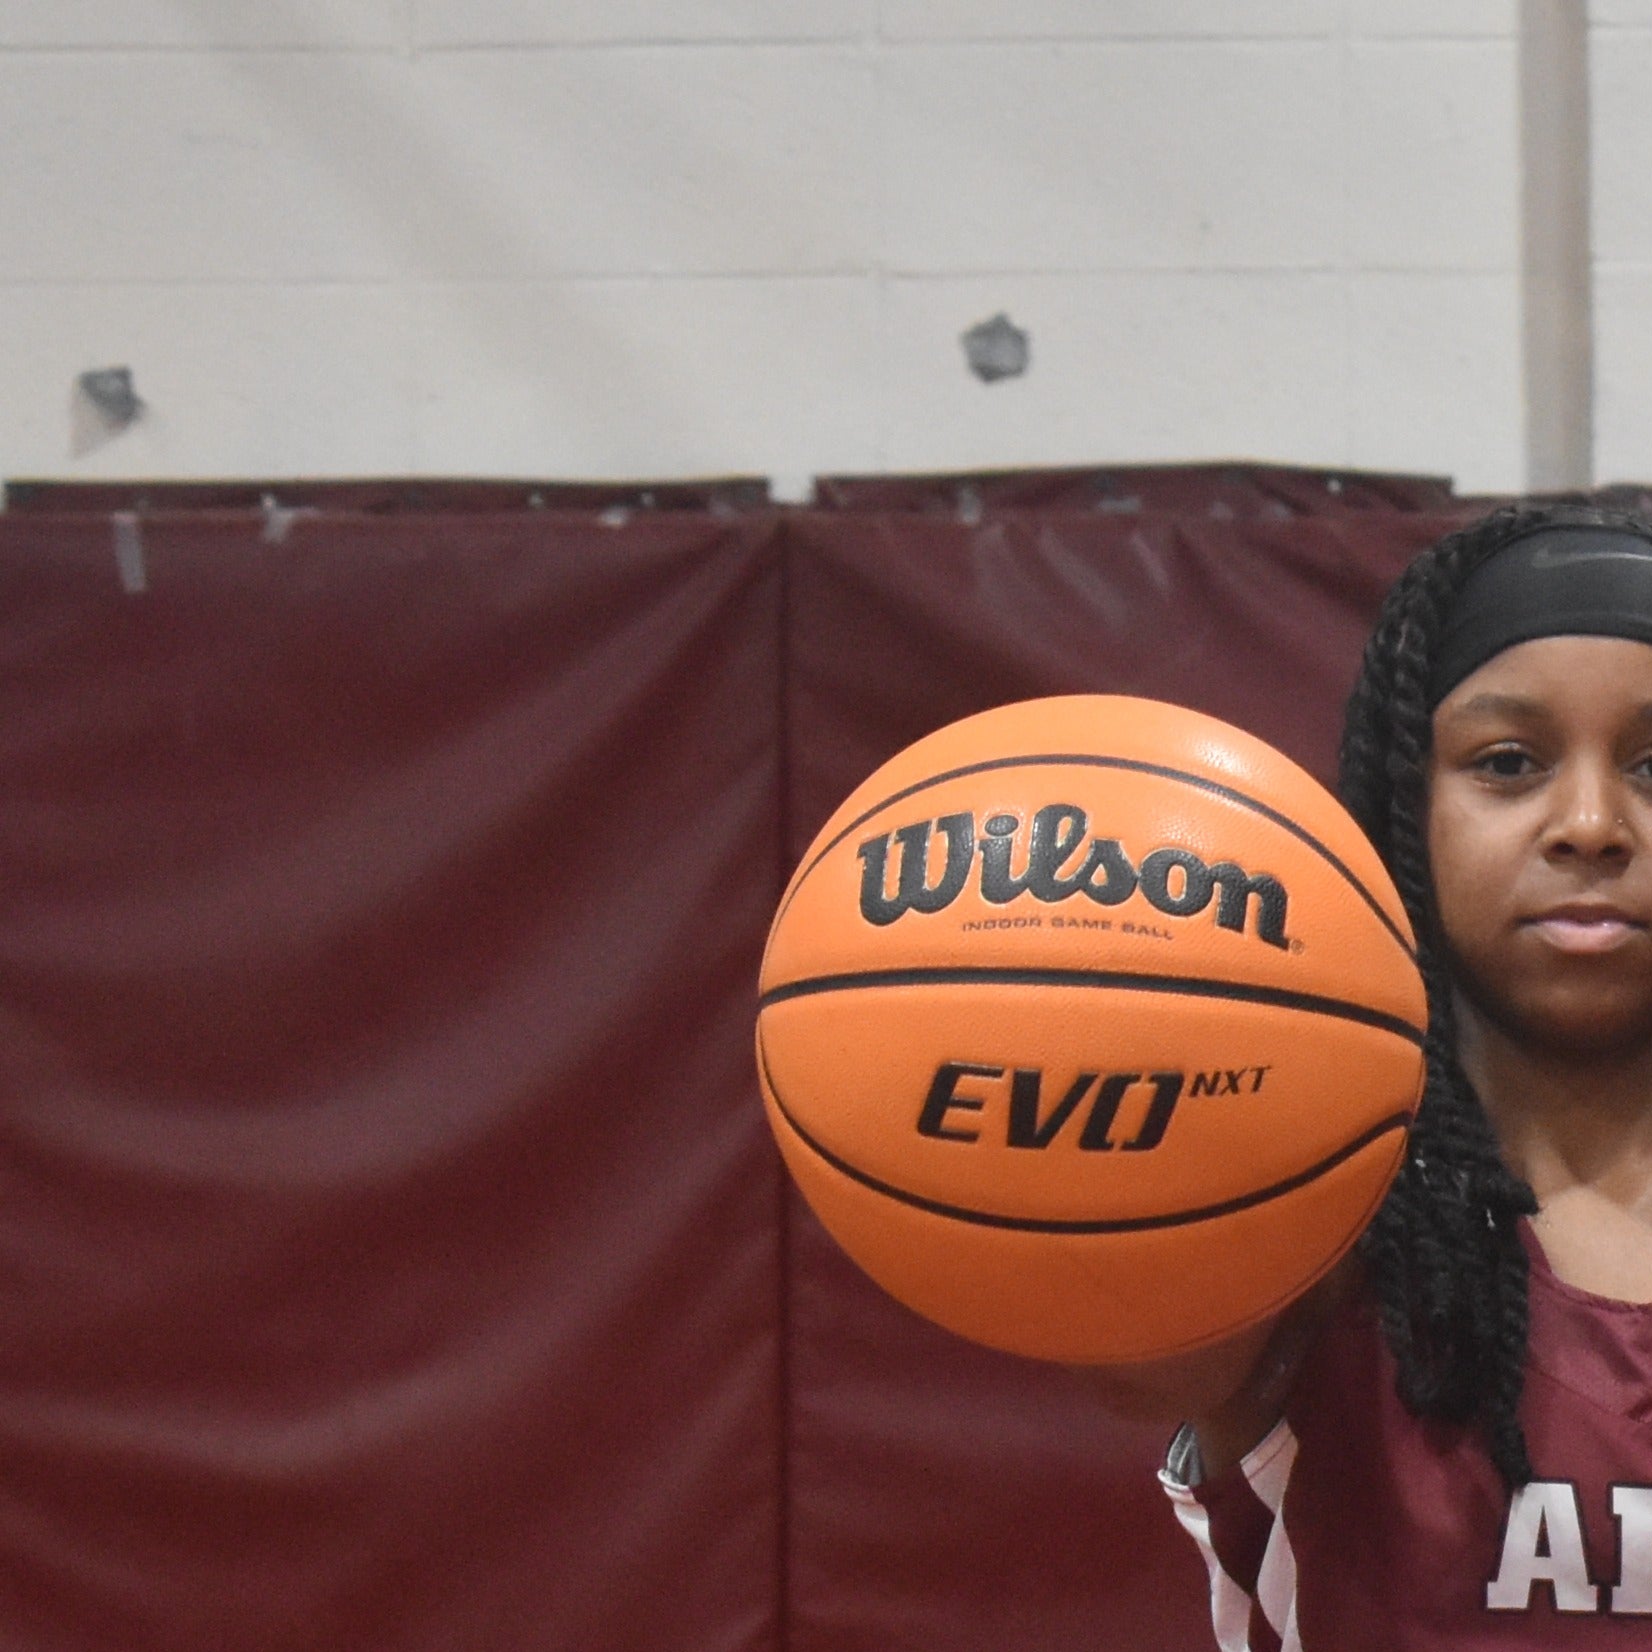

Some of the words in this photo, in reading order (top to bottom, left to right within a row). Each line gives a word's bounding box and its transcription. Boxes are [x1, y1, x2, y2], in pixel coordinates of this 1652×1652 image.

[857, 803, 1289, 952] Wilson
[962, 917, 1042, 933] INDOOR
[1051, 918, 1113, 932] GAME
[1122, 921, 1174, 941] BALL
[916, 1060, 1184, 1152] EVO
[1187, 1066, 1271, 1098] NXT
